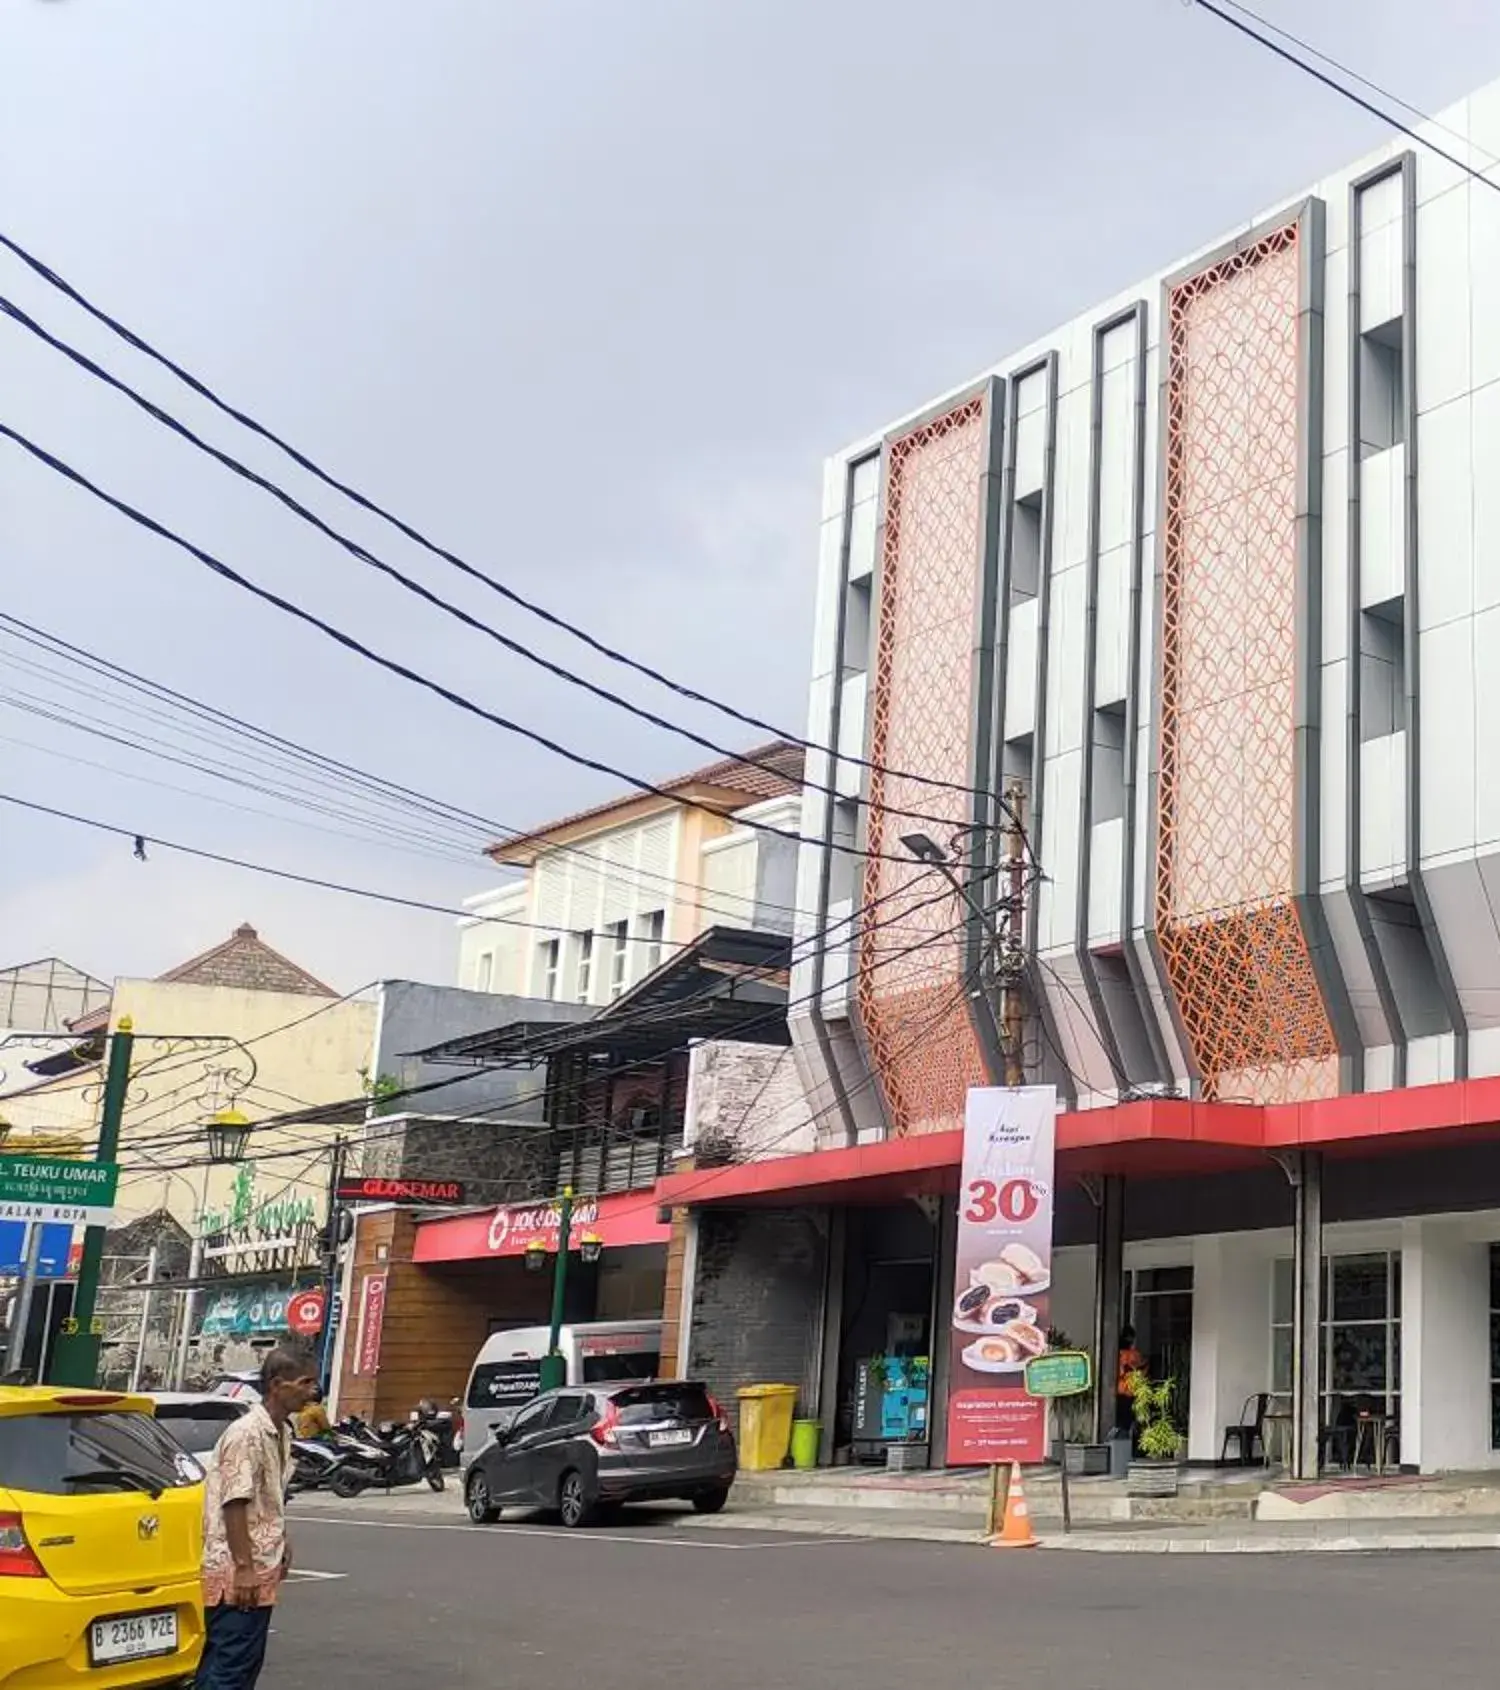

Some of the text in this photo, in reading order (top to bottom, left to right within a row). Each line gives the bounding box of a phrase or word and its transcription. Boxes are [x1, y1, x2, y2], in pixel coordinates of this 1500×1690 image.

[13, 1163, 60, 1179] TEUKU
[63, 1167, 107, 1183] UMAR
[96, 1627, 103, 1647] B
[112, 1619, 145, 1644] 2366
[151, 1615, 174, 1638] PZE
